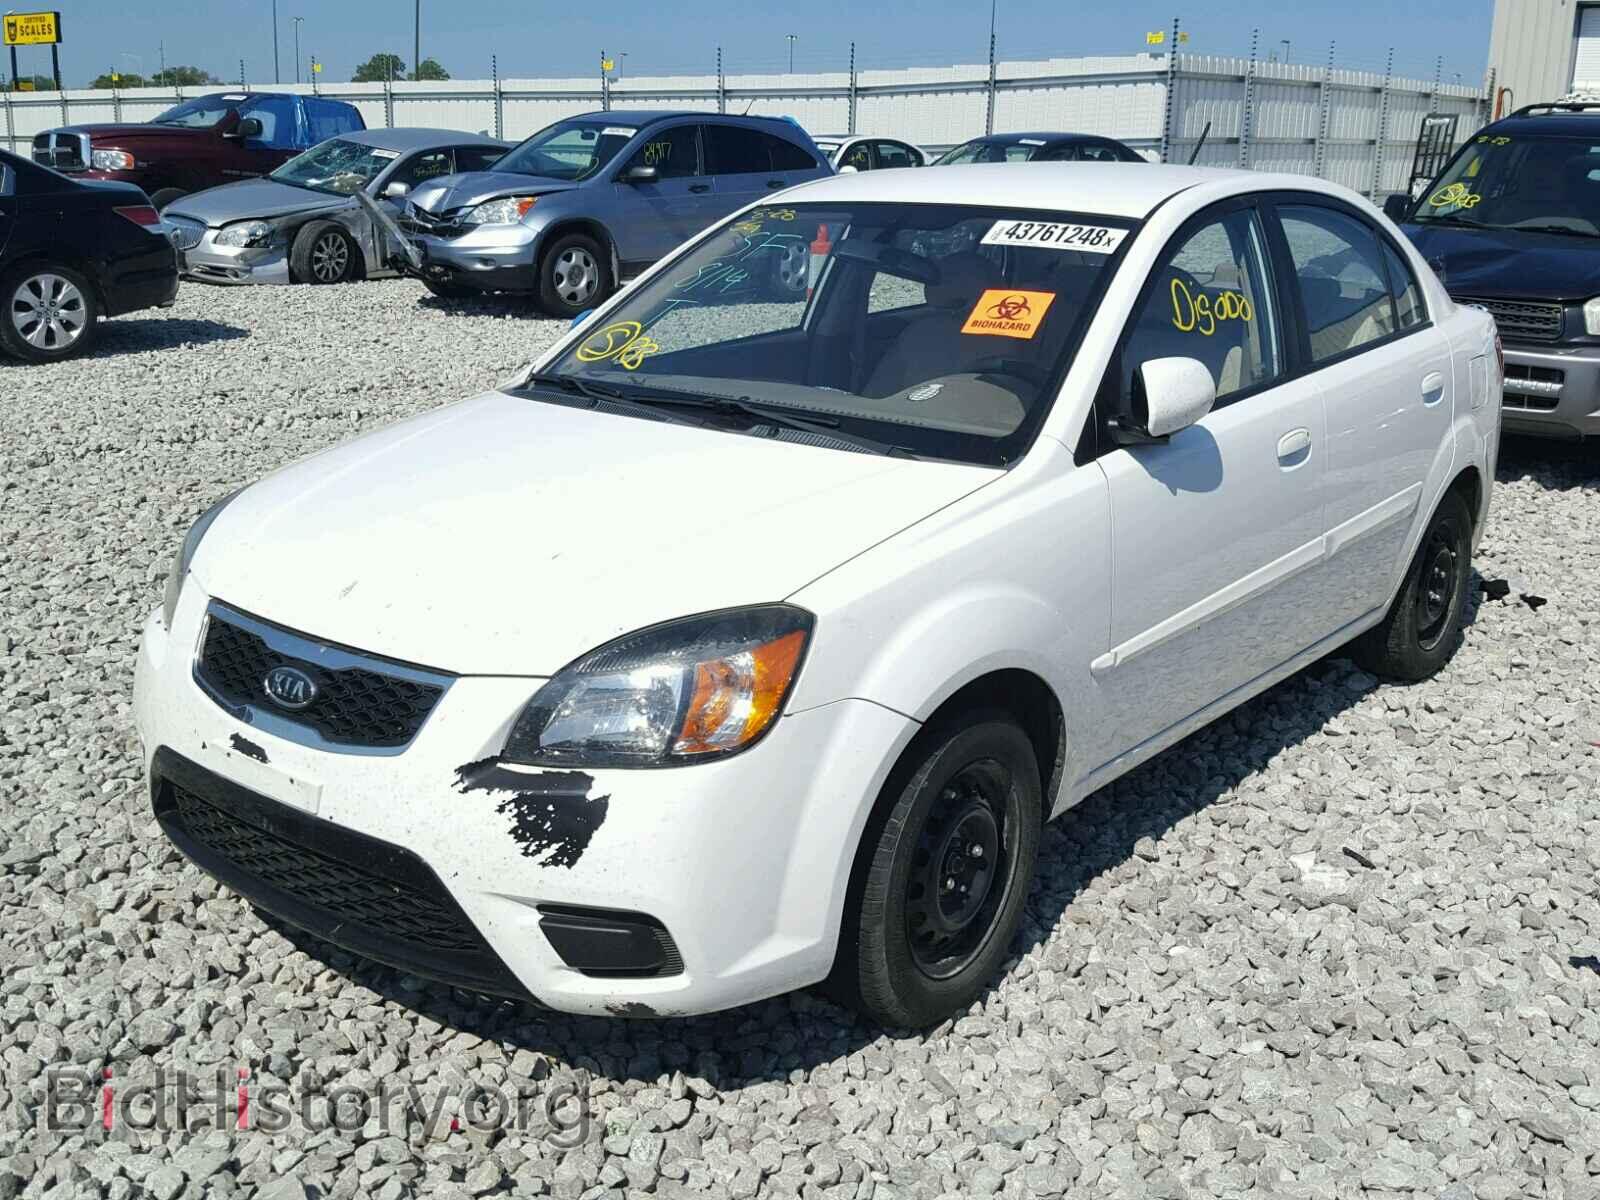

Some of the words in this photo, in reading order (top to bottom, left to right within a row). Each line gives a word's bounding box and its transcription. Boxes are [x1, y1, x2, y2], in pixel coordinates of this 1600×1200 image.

[19, 24, 53, 36] SCALES
[970, 319, 1031, 332] BIOHAZARD
[270, 670, 307, 703] KIA
